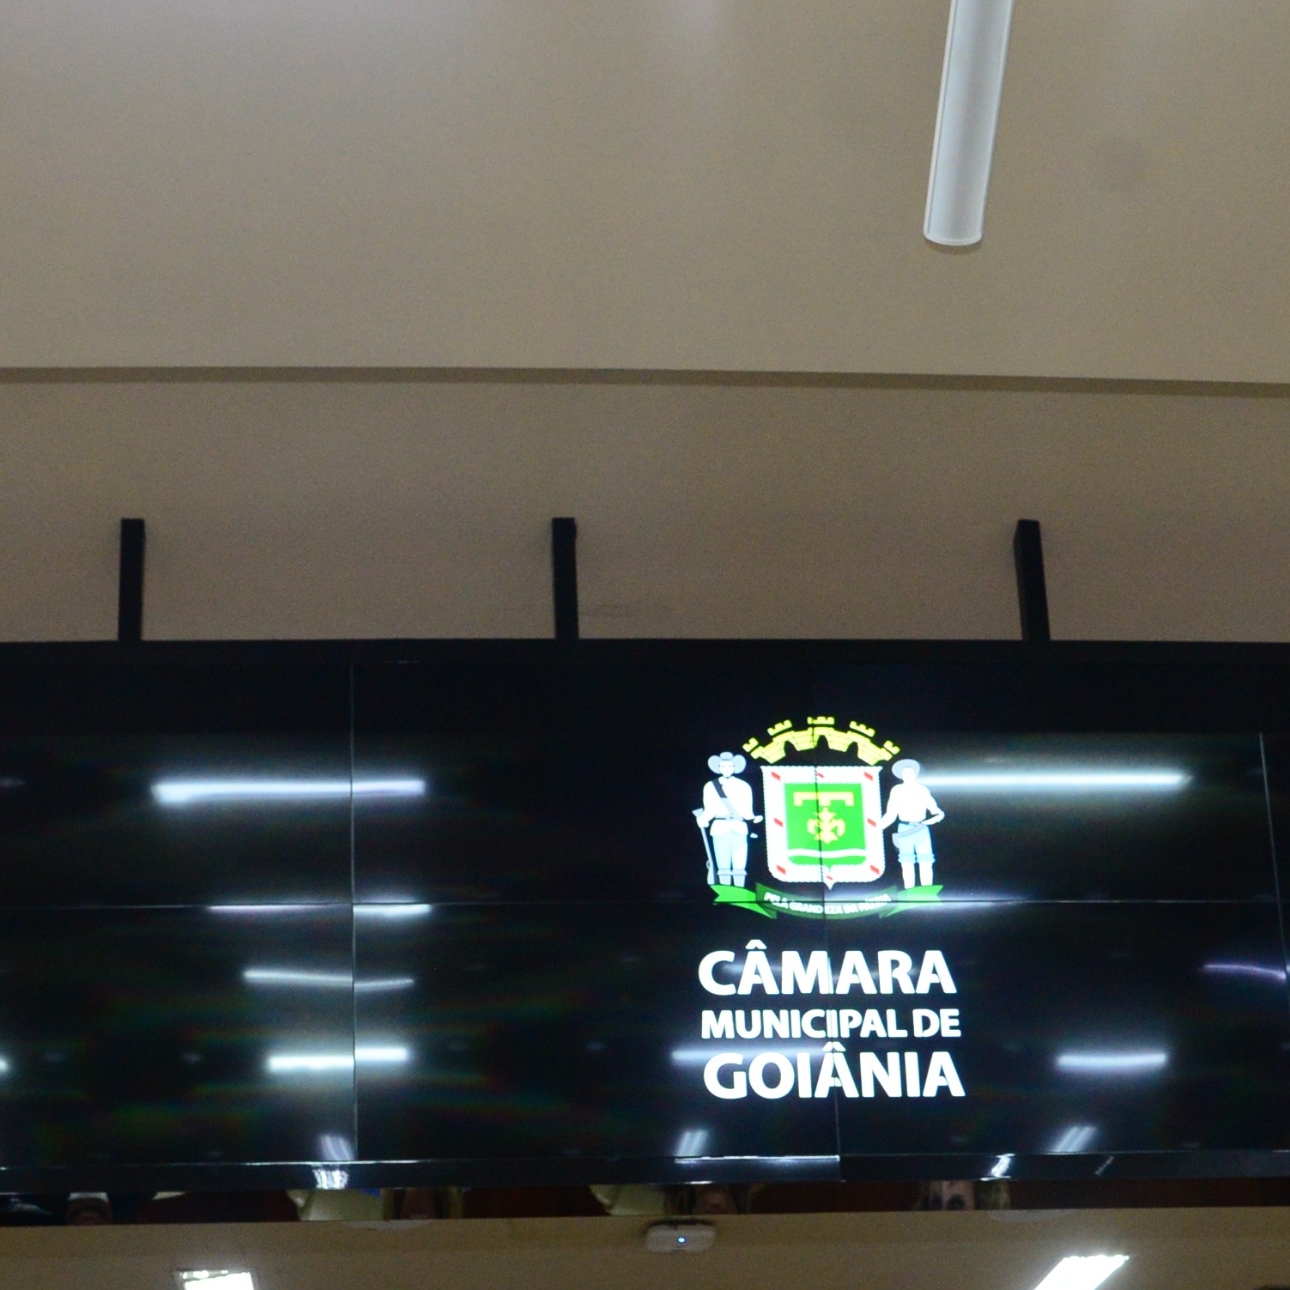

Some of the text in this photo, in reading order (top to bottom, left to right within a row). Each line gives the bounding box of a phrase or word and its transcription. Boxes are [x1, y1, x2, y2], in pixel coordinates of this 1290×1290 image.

[698, 939, 957, 995] CÂMARA
[701, 1009, 961, 1038] MUNICIPAL DE
[703, 1041, 966, 1099] GOIÂNIA
